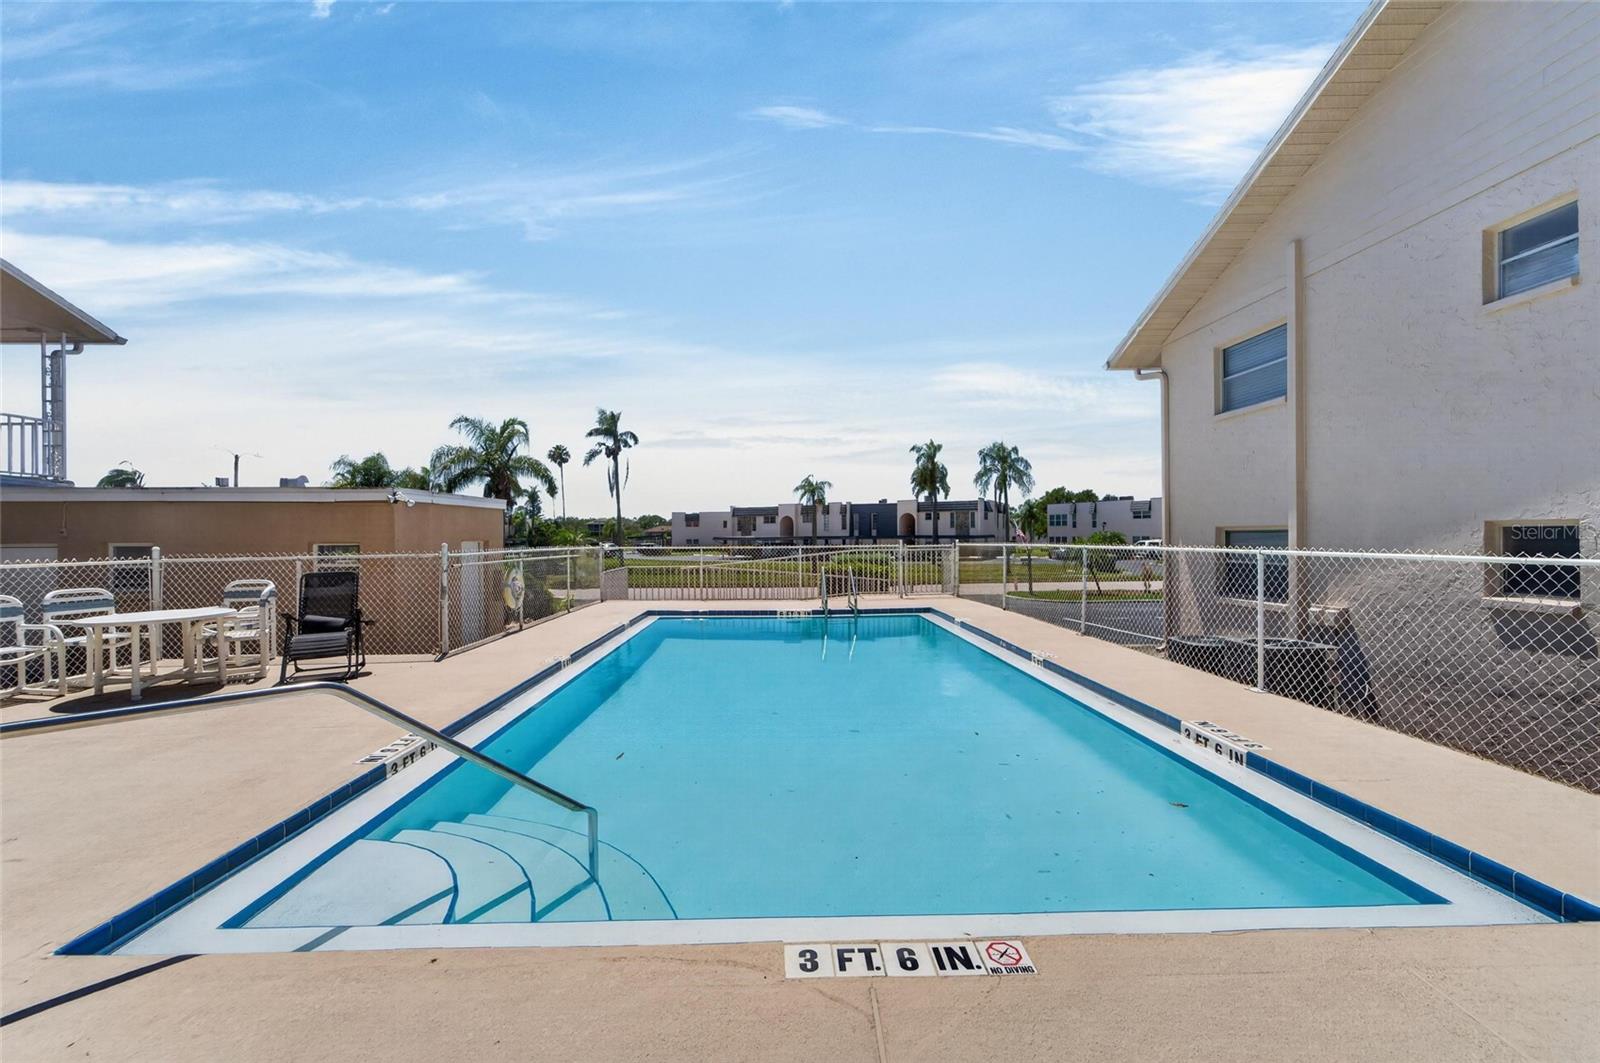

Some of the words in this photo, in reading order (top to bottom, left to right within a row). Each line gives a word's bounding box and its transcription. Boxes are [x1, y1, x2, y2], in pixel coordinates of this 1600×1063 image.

[391, 763, 398, 775] 3
[403, 751, 416, 768] FT
[420, 746, 426, 757] 6
[1195, 733, 1209, 748] FT
[1214, 743, 1222, 755] 6
[1229, 748, 1244, 766] IN
[798, 949, 819, 973] 3
[836, 948, 882, 972] FT.
[895, 947, 920, 971] 6
[932, 946, 982, 971] IN.
[990, 966, 1003, 975] NO
[1004, 966, 1035, 974] DIVING
